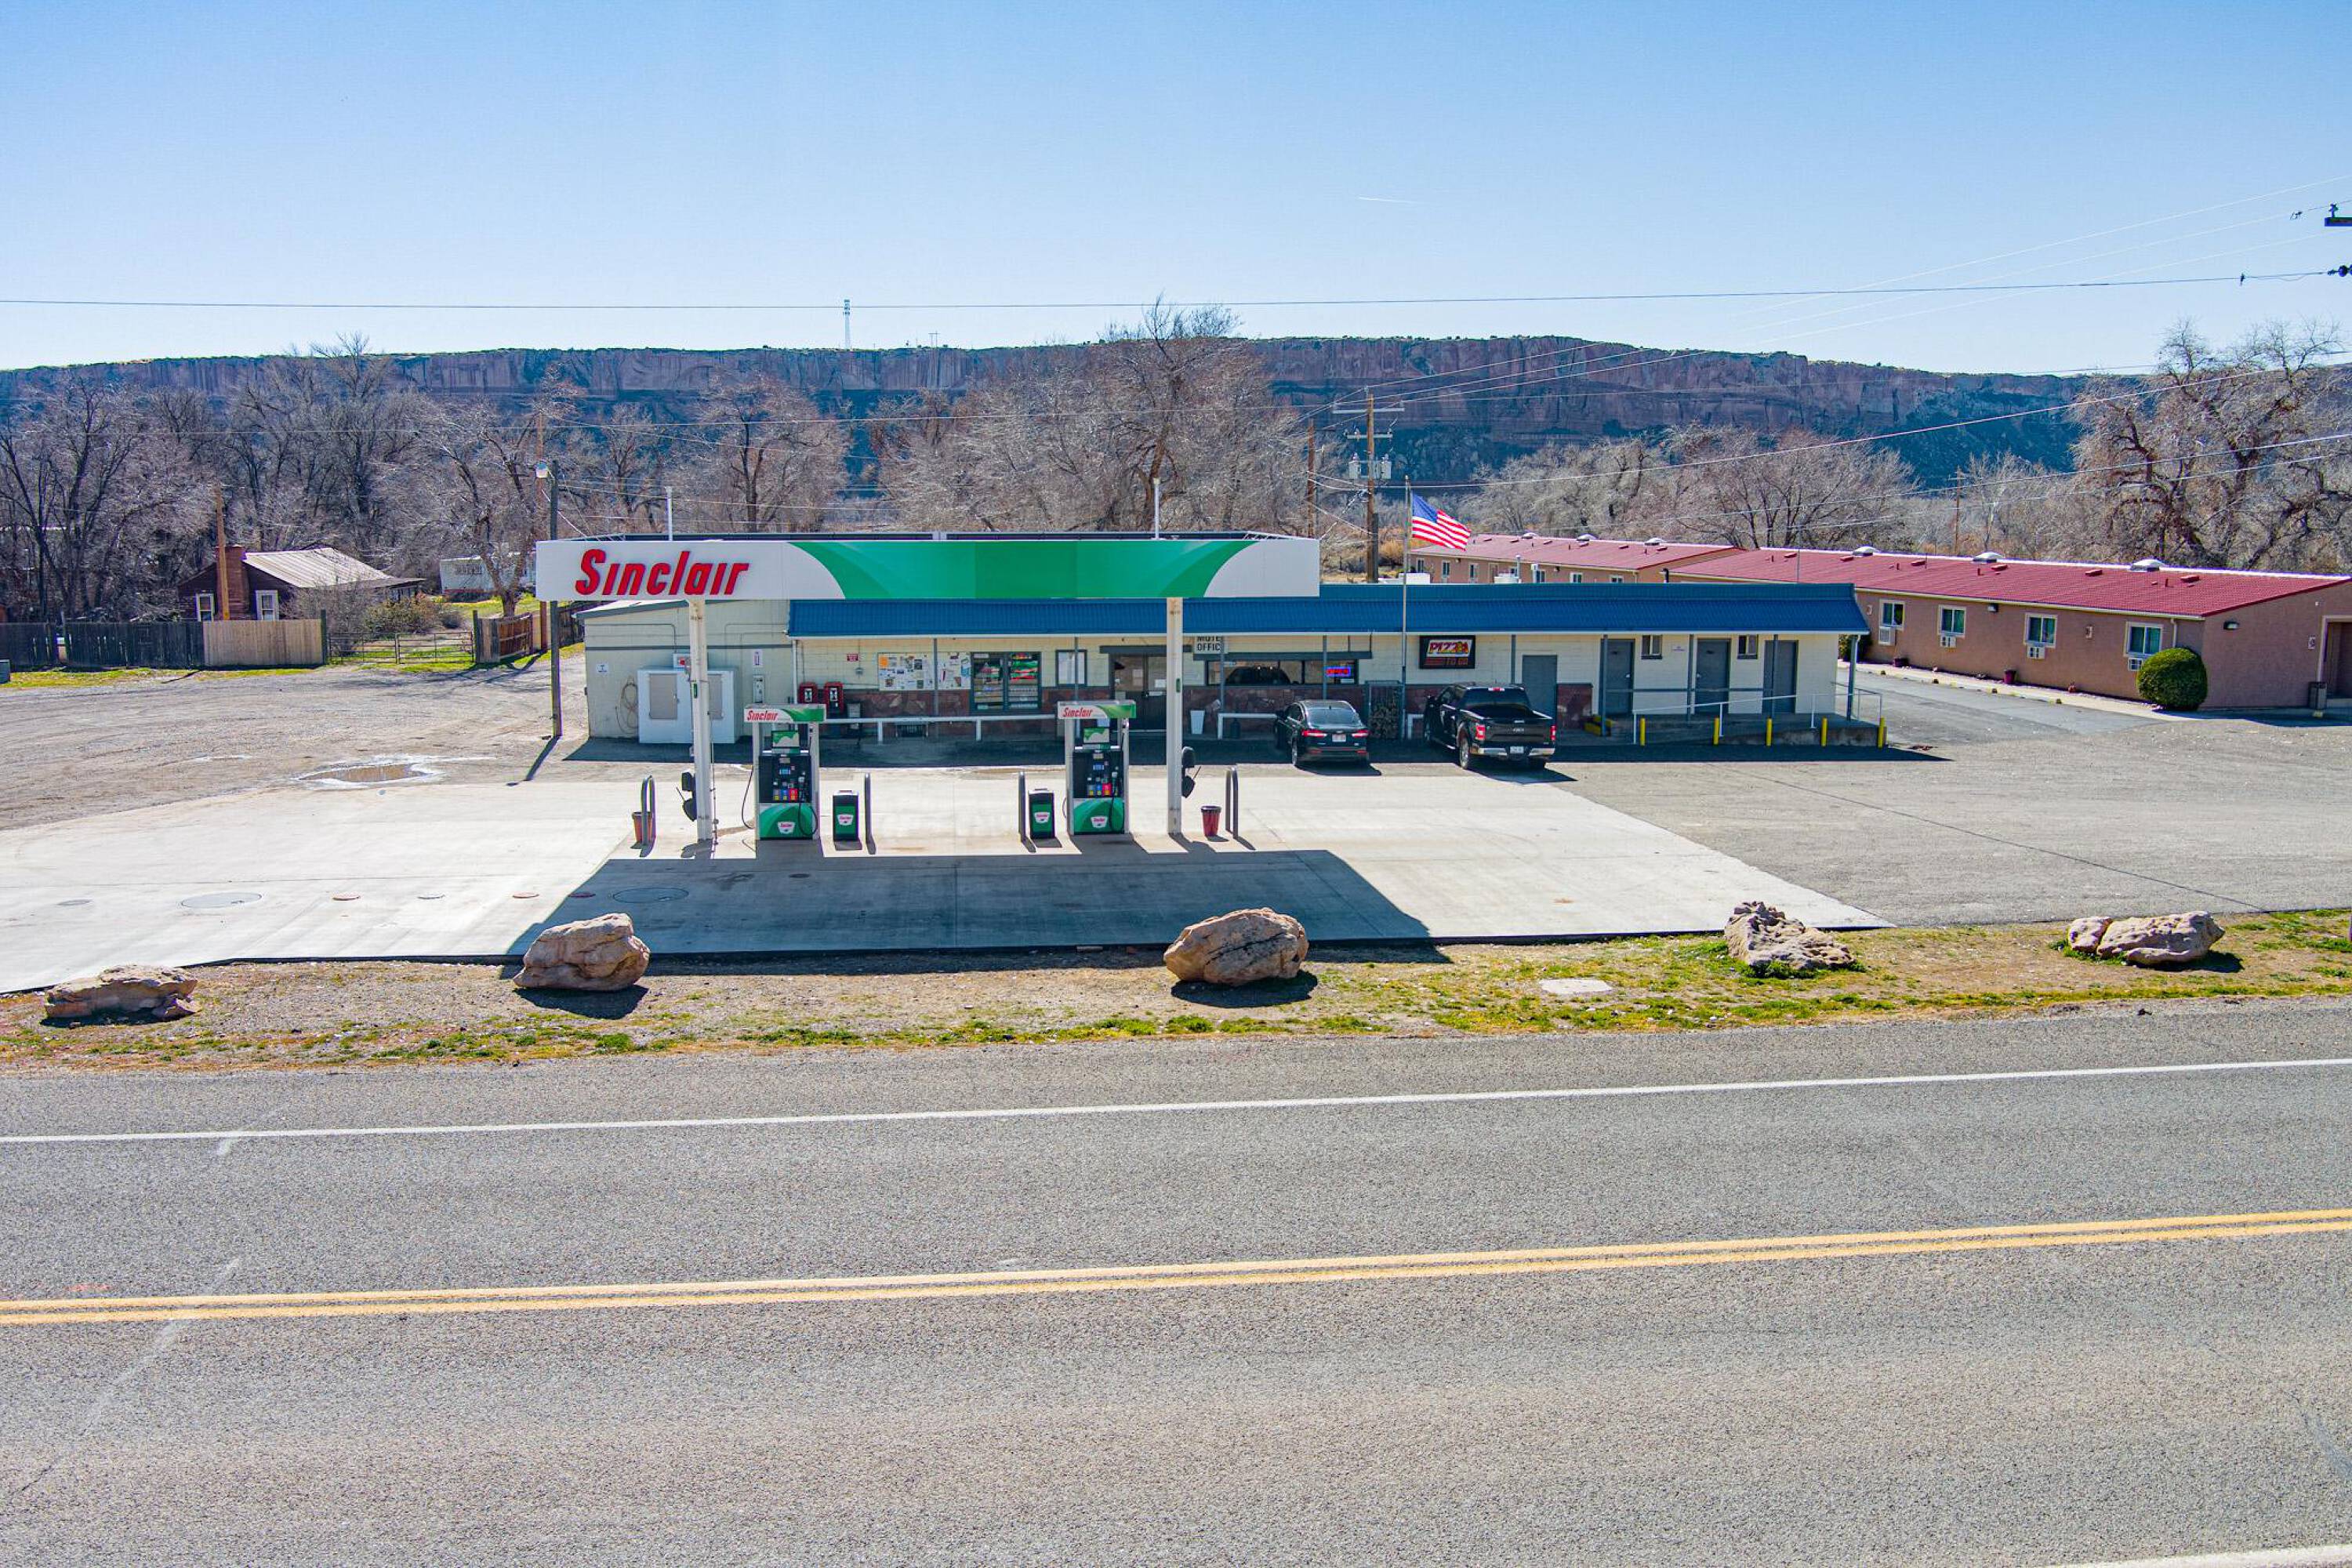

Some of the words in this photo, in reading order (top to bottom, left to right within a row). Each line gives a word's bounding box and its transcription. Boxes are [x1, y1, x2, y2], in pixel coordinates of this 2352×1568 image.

[575, 549, 750, 595] Sinclair
[747, 710, 778, 720] Sinclair
[1062, 707, 1093, 717] Sinclair
